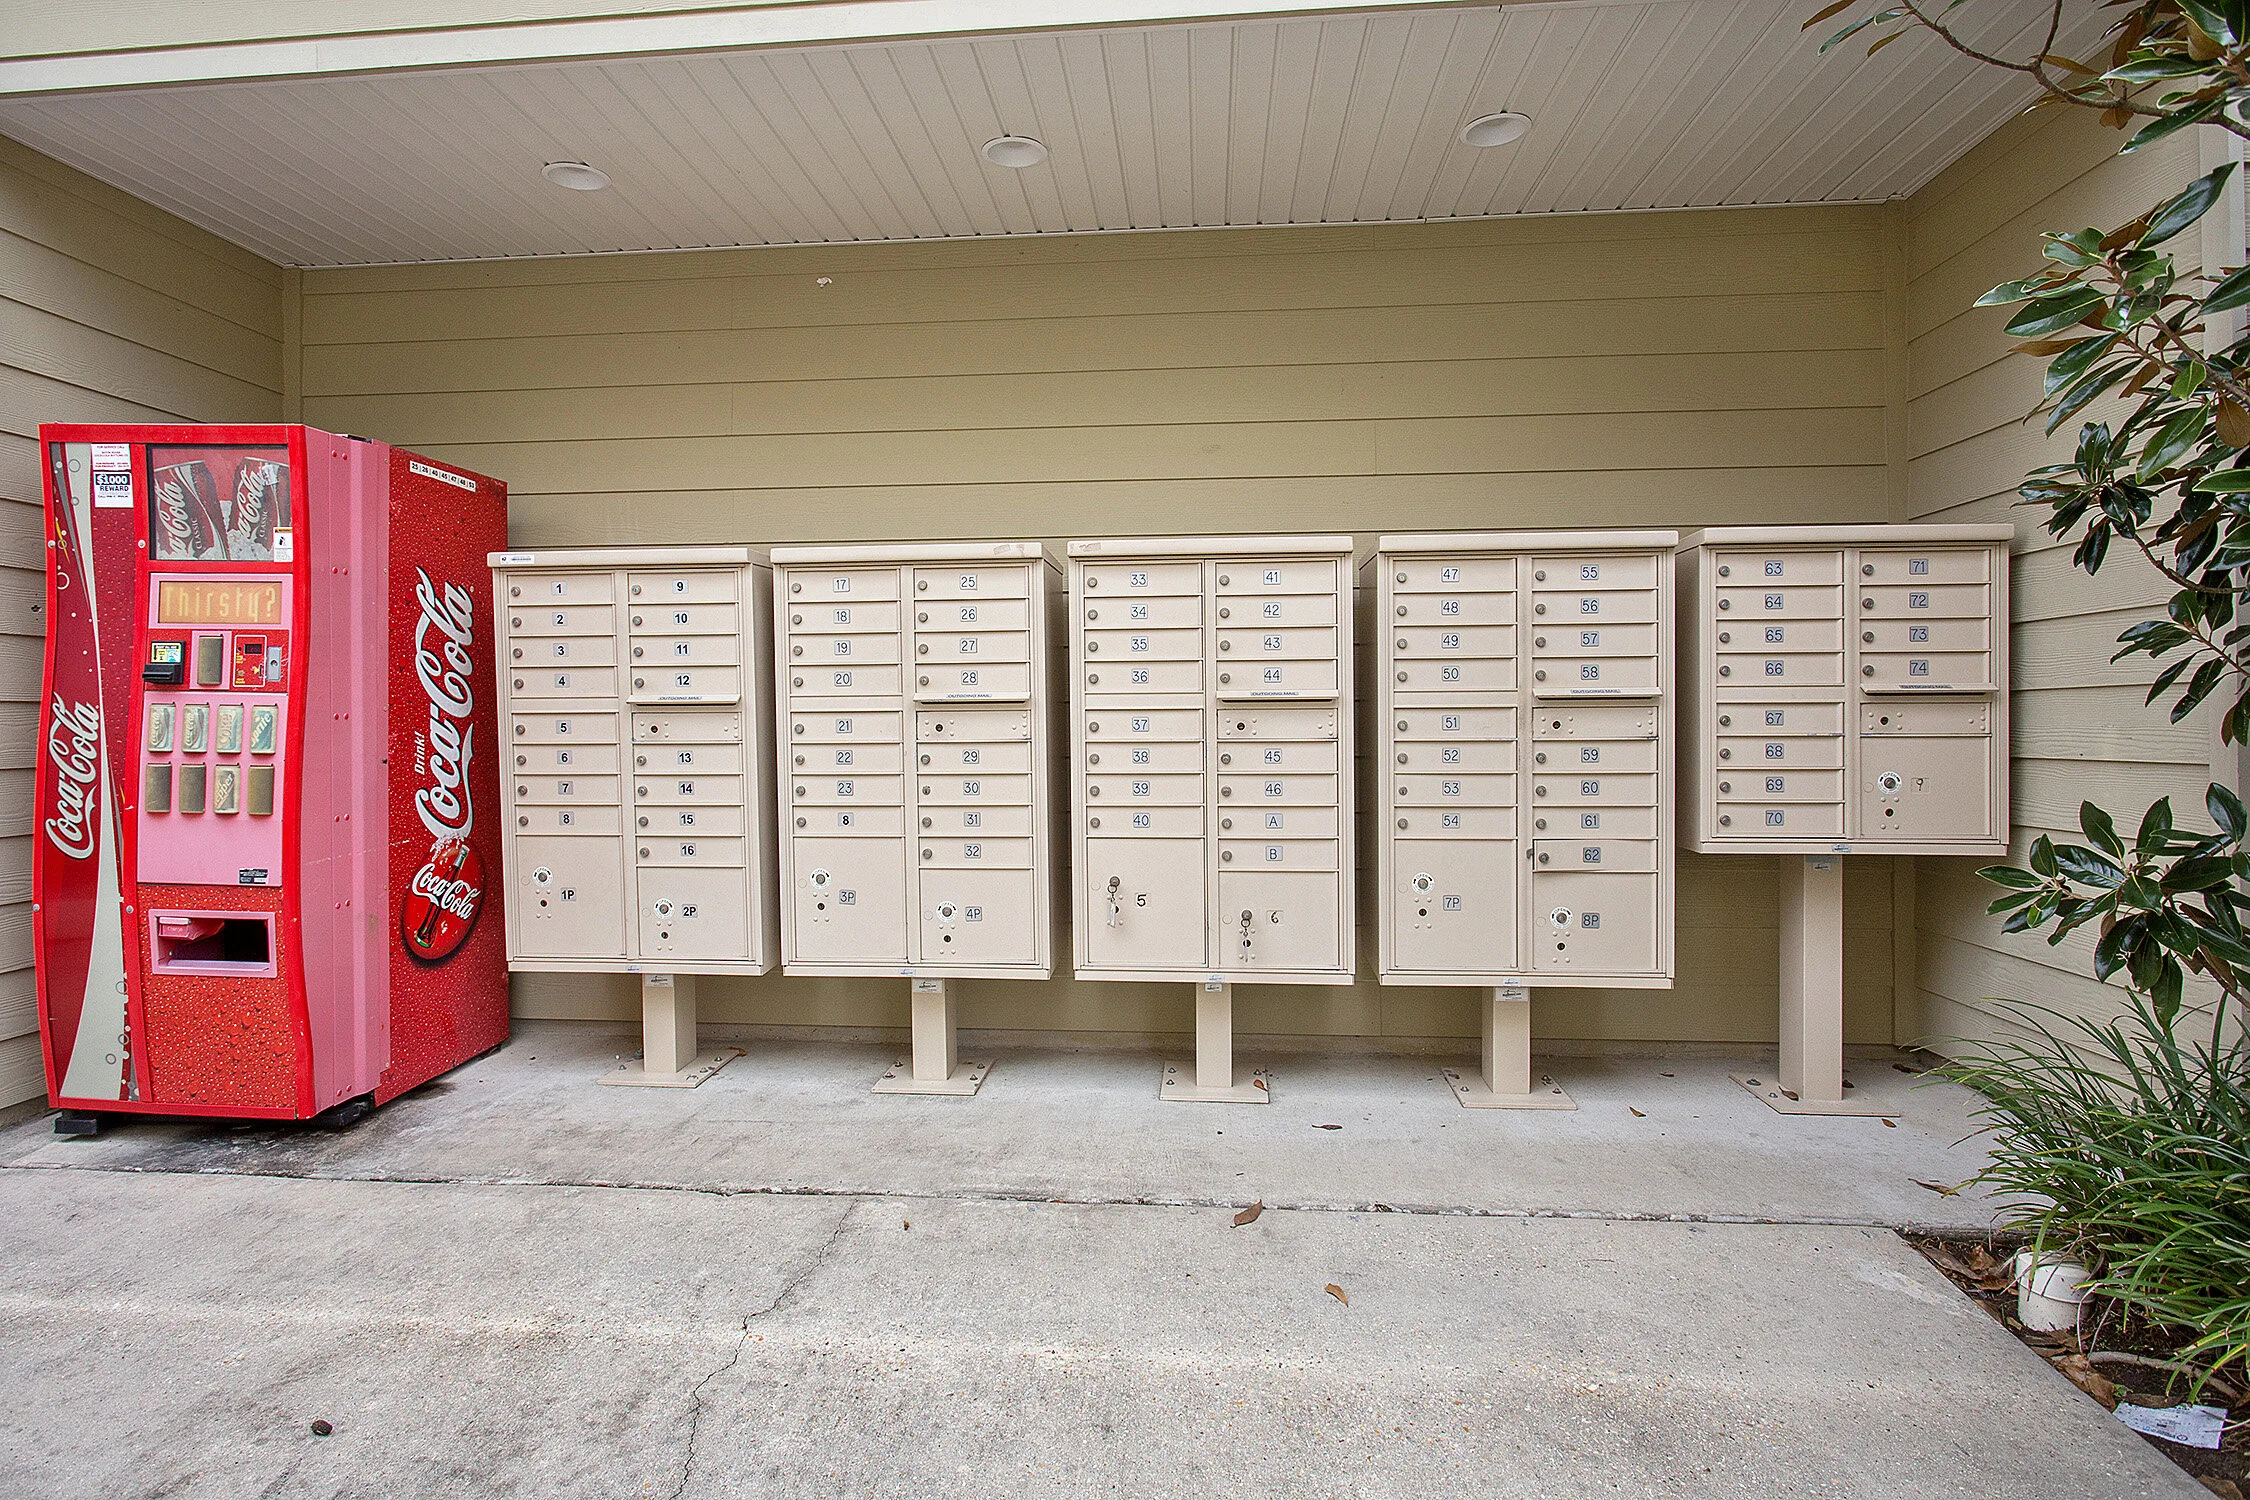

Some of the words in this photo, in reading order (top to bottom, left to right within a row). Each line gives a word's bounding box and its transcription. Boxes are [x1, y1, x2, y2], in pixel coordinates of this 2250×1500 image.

[97, 474, 128, 485] $1000
[1582, 566, 1598, 578] 55
[1765, 562, 1782, 575] 63
[1912, 561, 1924, 572] 71
[1131, 574, 1146, 586] 33
[1266, 572, 1278, 582] 41
[1443, 568, 1458, 580] 47
[676, 582, 684, 592] 9
[836, 579, 846, 590] 17
[961, 576, 975, 588] 25
[556, 584, 562, 594] 1
[165, 586, 276, 622] Thirsty?
[1582, 600, 1598, 612] 56
[1765, 596, 1782, 608] 64
[1911, 594, 1926, 606] 72
[961, 608, 976, 620] 26
[1131, 606, 1146, 618] 34
[1264, 604, 1279, 616] 42
[1443, 602, 1458, 614] 48
[557, 614, 564, 624] 2
[675, 613, 688, 624] 10
[836, 610, 848, 622] 18
[1443, 634, 1458, 646] 49
[1582, 633, 1598, 645] 57
[1766, 629, 1783, 642] 65
[1911, 628, 1927, 640] 73
[837, 642, 848, 654] 19
[962, 640, 975, 652] 27
[1132, 638, 1147, 650] 35
[1264, 637, 1280, 648] 43
[558, 646, 564, 656] 3
[676, 644, 688, 654] 11
[1443, 668, 1459, 680] 50
[1582, 666, 1598, 678] 58
[1766, 662, 1783, 675] 66
[1911, 662, 1927, 674] 74
[558, 676, 566, 686] 4
[677, 675, 690, 685] 12
[836, 673, 850, 684] 20
[962, 672, 976, 684] 28
[1132, 670, 1148, 682] 36
[1264, 670, 1281, 682] 44
[1445, 717, 1457, 728] 51
[1766, 712, 1782, 725] 67
[560, 722, 567, 732] 5
[838, 720, 849, 732] 21
[1132, 719, 1148, 731] 37
[414, 732, 425, 775] Drink!
[561, 752, 568, 762] 6
[964, 750, 978, 762] 29
[1133, 751, 1148, 763] 38
[1265, 751, 1281, 762] 45
[1444, 750, 1458, 761] 52
[1583, 749, 1598, 761] 59
[1766, 745, 1783, 757] 68
[679, 752, 692, 763] 13
[838, 752, 851, 763] 22
[562, 783, 569, 793] 7
[680, 784, 692, 794] 14
[838, 782, 852, 794] 23
[964, 782, 979, 794] 30
[1133, 782, 1148, 794] 39
[1265, 783, 1282, 794] 46
[1444, 782, 1459, 794] 53
[1582, 782, 1598, 794] 60
[1766, 778, 1783, 791] 69
[563, 814, 570, 824] 8
[681, 814, 694, 824] 15
[842, 815, 850, 826] 8
[967, 814, 978, 825] 31
[1133, 814, 1149, 826] 40
[1269, 816, 1278, 827] A
[1443, 815, 1458, 826] 54
[1585, 814, 1596, 826] 61
[1766, 812, 1782, 824] 70
[682, 845, 694, 856] 16
[965, 845, 980, 857] 32
[1270, 848, 1278, 860] B
[1584, 849, 1600, 861] 62
[562, 890, 574, 900] 1P
[840, 891, 854, 902] 3P
[1136, 894, 1146, 907] 5
[1445, 897, 1460, 908] 7P
[683, 906, 696, 916] 2P
[966, 908, 981, 919] 4P
[1271, 911, 1279, 924] 6
[1583, 914, 1599, 926] 8P
